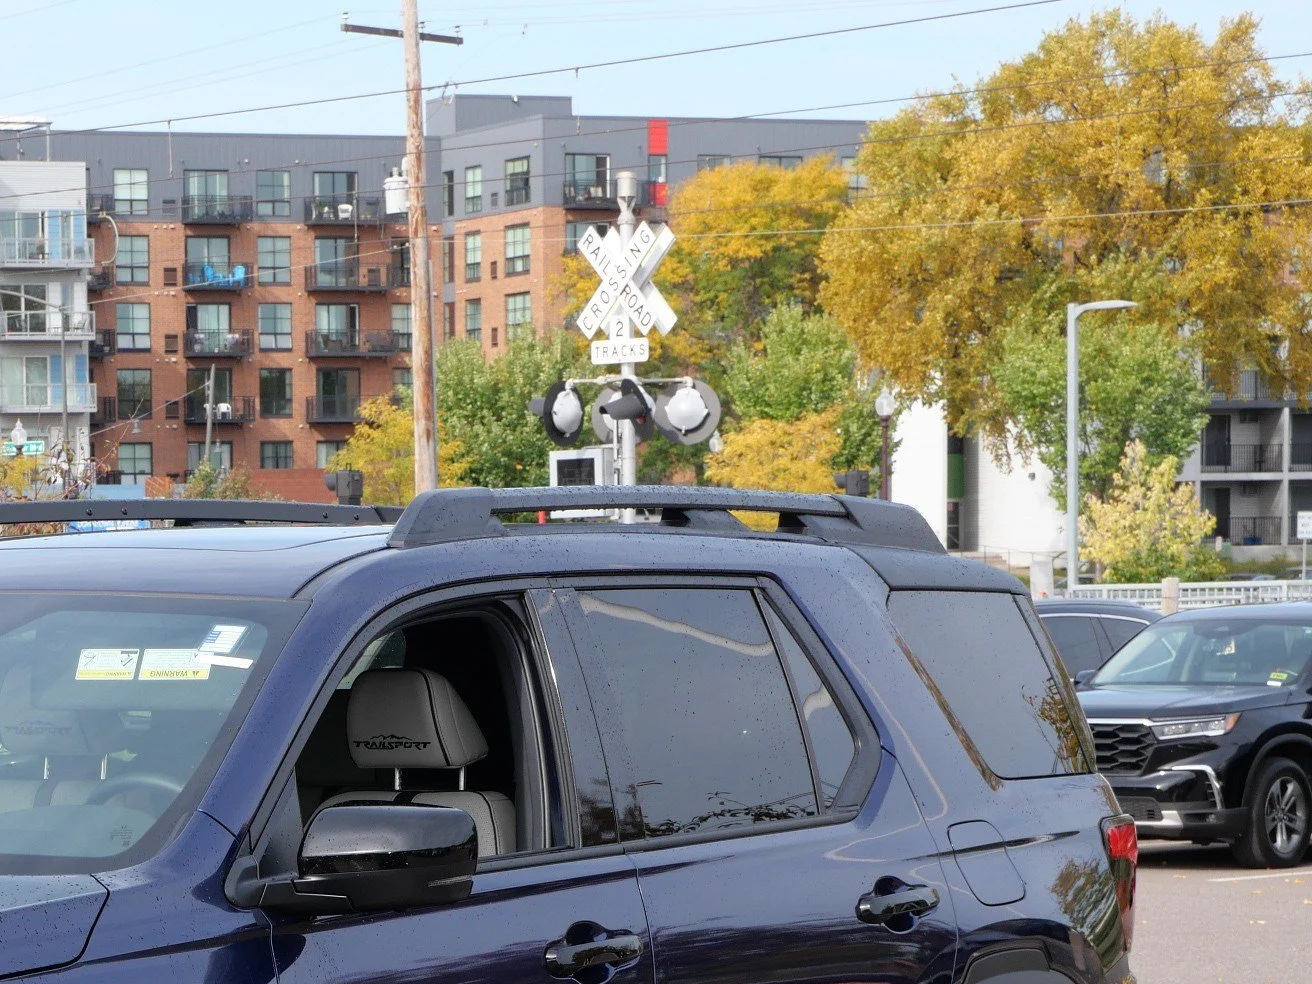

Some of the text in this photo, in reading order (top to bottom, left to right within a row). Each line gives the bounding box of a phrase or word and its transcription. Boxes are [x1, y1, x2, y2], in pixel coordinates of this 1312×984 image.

[582, 229, 650, 331] CROSSING
[615, 321, 624, 337] 2
[594, 343, 646, 358] TRACKS
[149, 670, 188, 678] WARNING
[353, 741, 431, 750] TRAILSPORT
